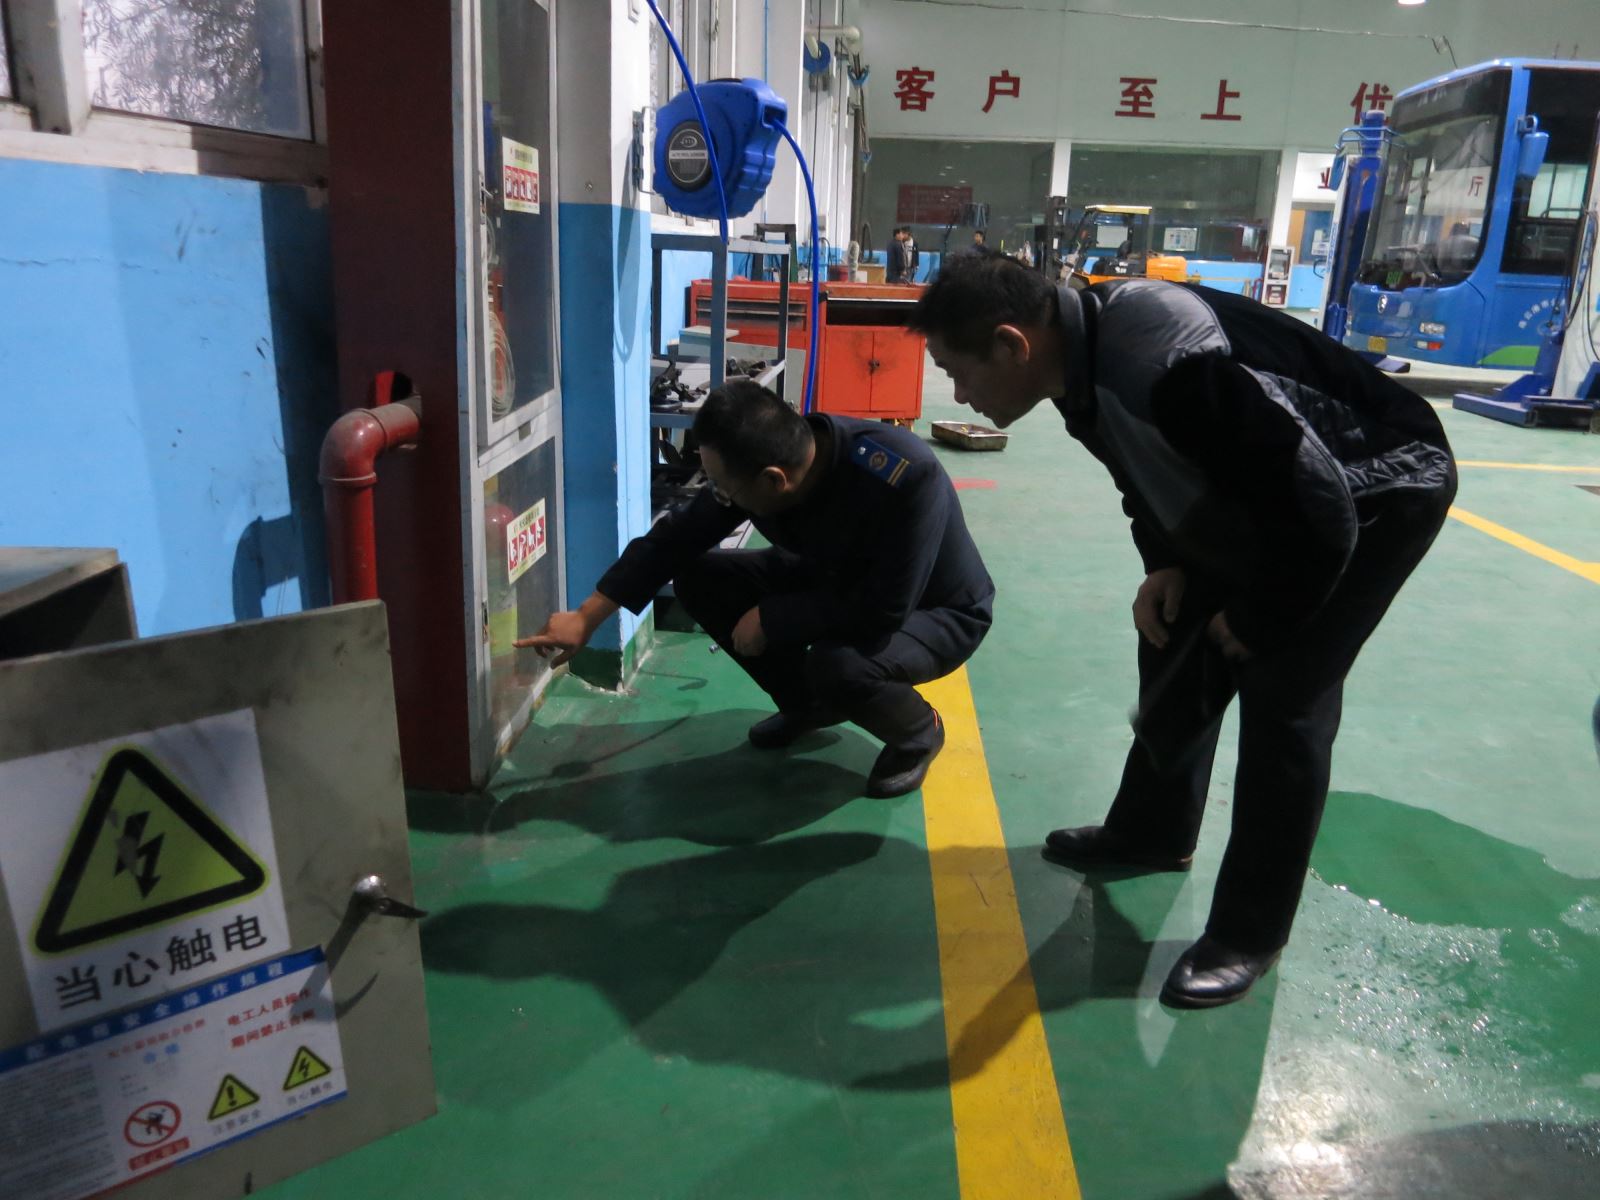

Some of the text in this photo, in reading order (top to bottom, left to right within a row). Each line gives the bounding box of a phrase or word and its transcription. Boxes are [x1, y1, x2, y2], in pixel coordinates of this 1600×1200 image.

[1467, 175, 1484, 197] 厅
[55, 914, 268, 1010] 当心触电
